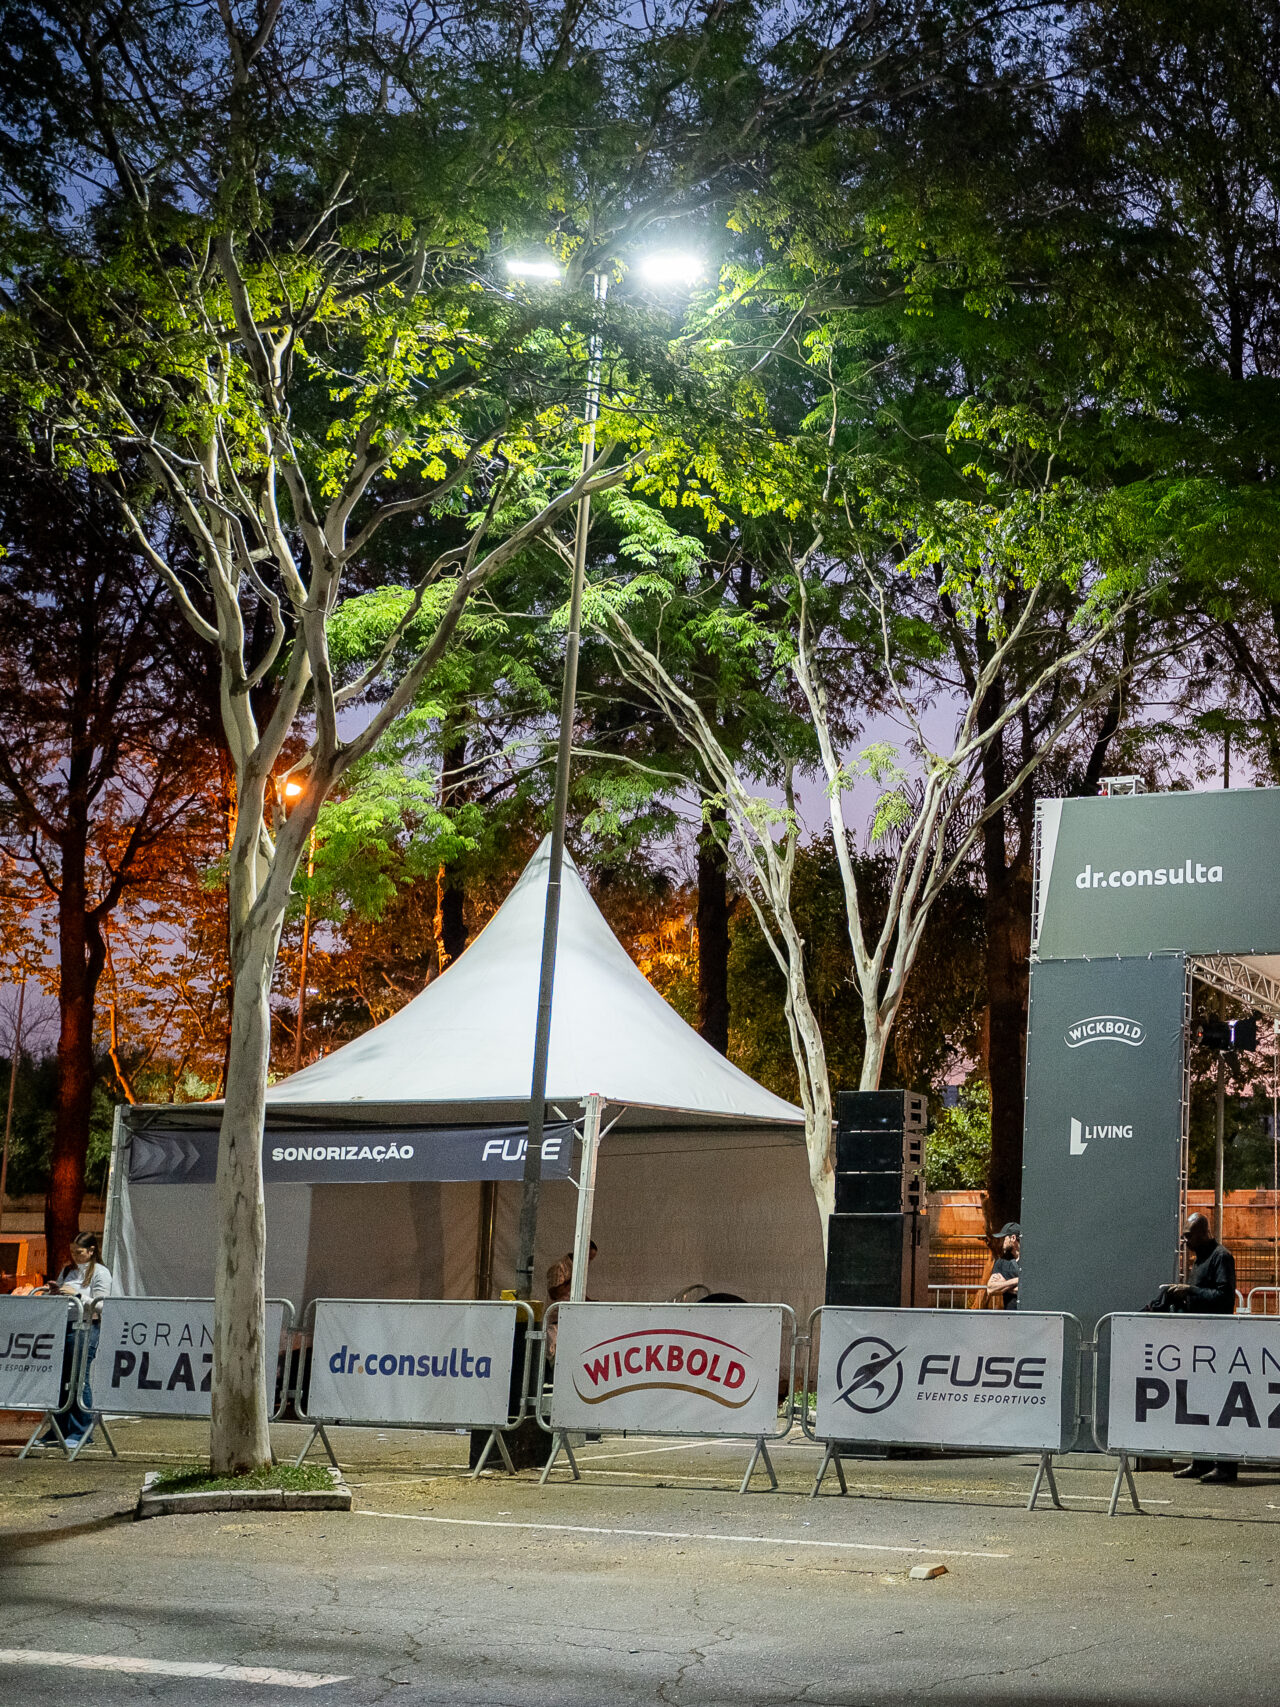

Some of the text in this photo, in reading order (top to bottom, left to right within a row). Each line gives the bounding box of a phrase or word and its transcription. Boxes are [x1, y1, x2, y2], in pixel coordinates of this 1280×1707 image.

[1075, 859, 1223, 890] dr.consulta
[1069, 1020, 1142, 1044] WICKBOLD
[1085, 1123, 1133, 1140] LIVING
[272, 1141, 415, 1164] SONORIZAÇÃO
[131, 1322, 214, 1347] GRAN
[5, 1364, 53, 1373] ESPORTIVOS
[329, 1344, 491, 1379] dr.consulta
[583, 1345, 748, 1390] WICKBOLD
[918, 1354, 1046, 1390] FUSE
[917, 1392, 1046, 1405] EVENTOS ESPORTIVOS
